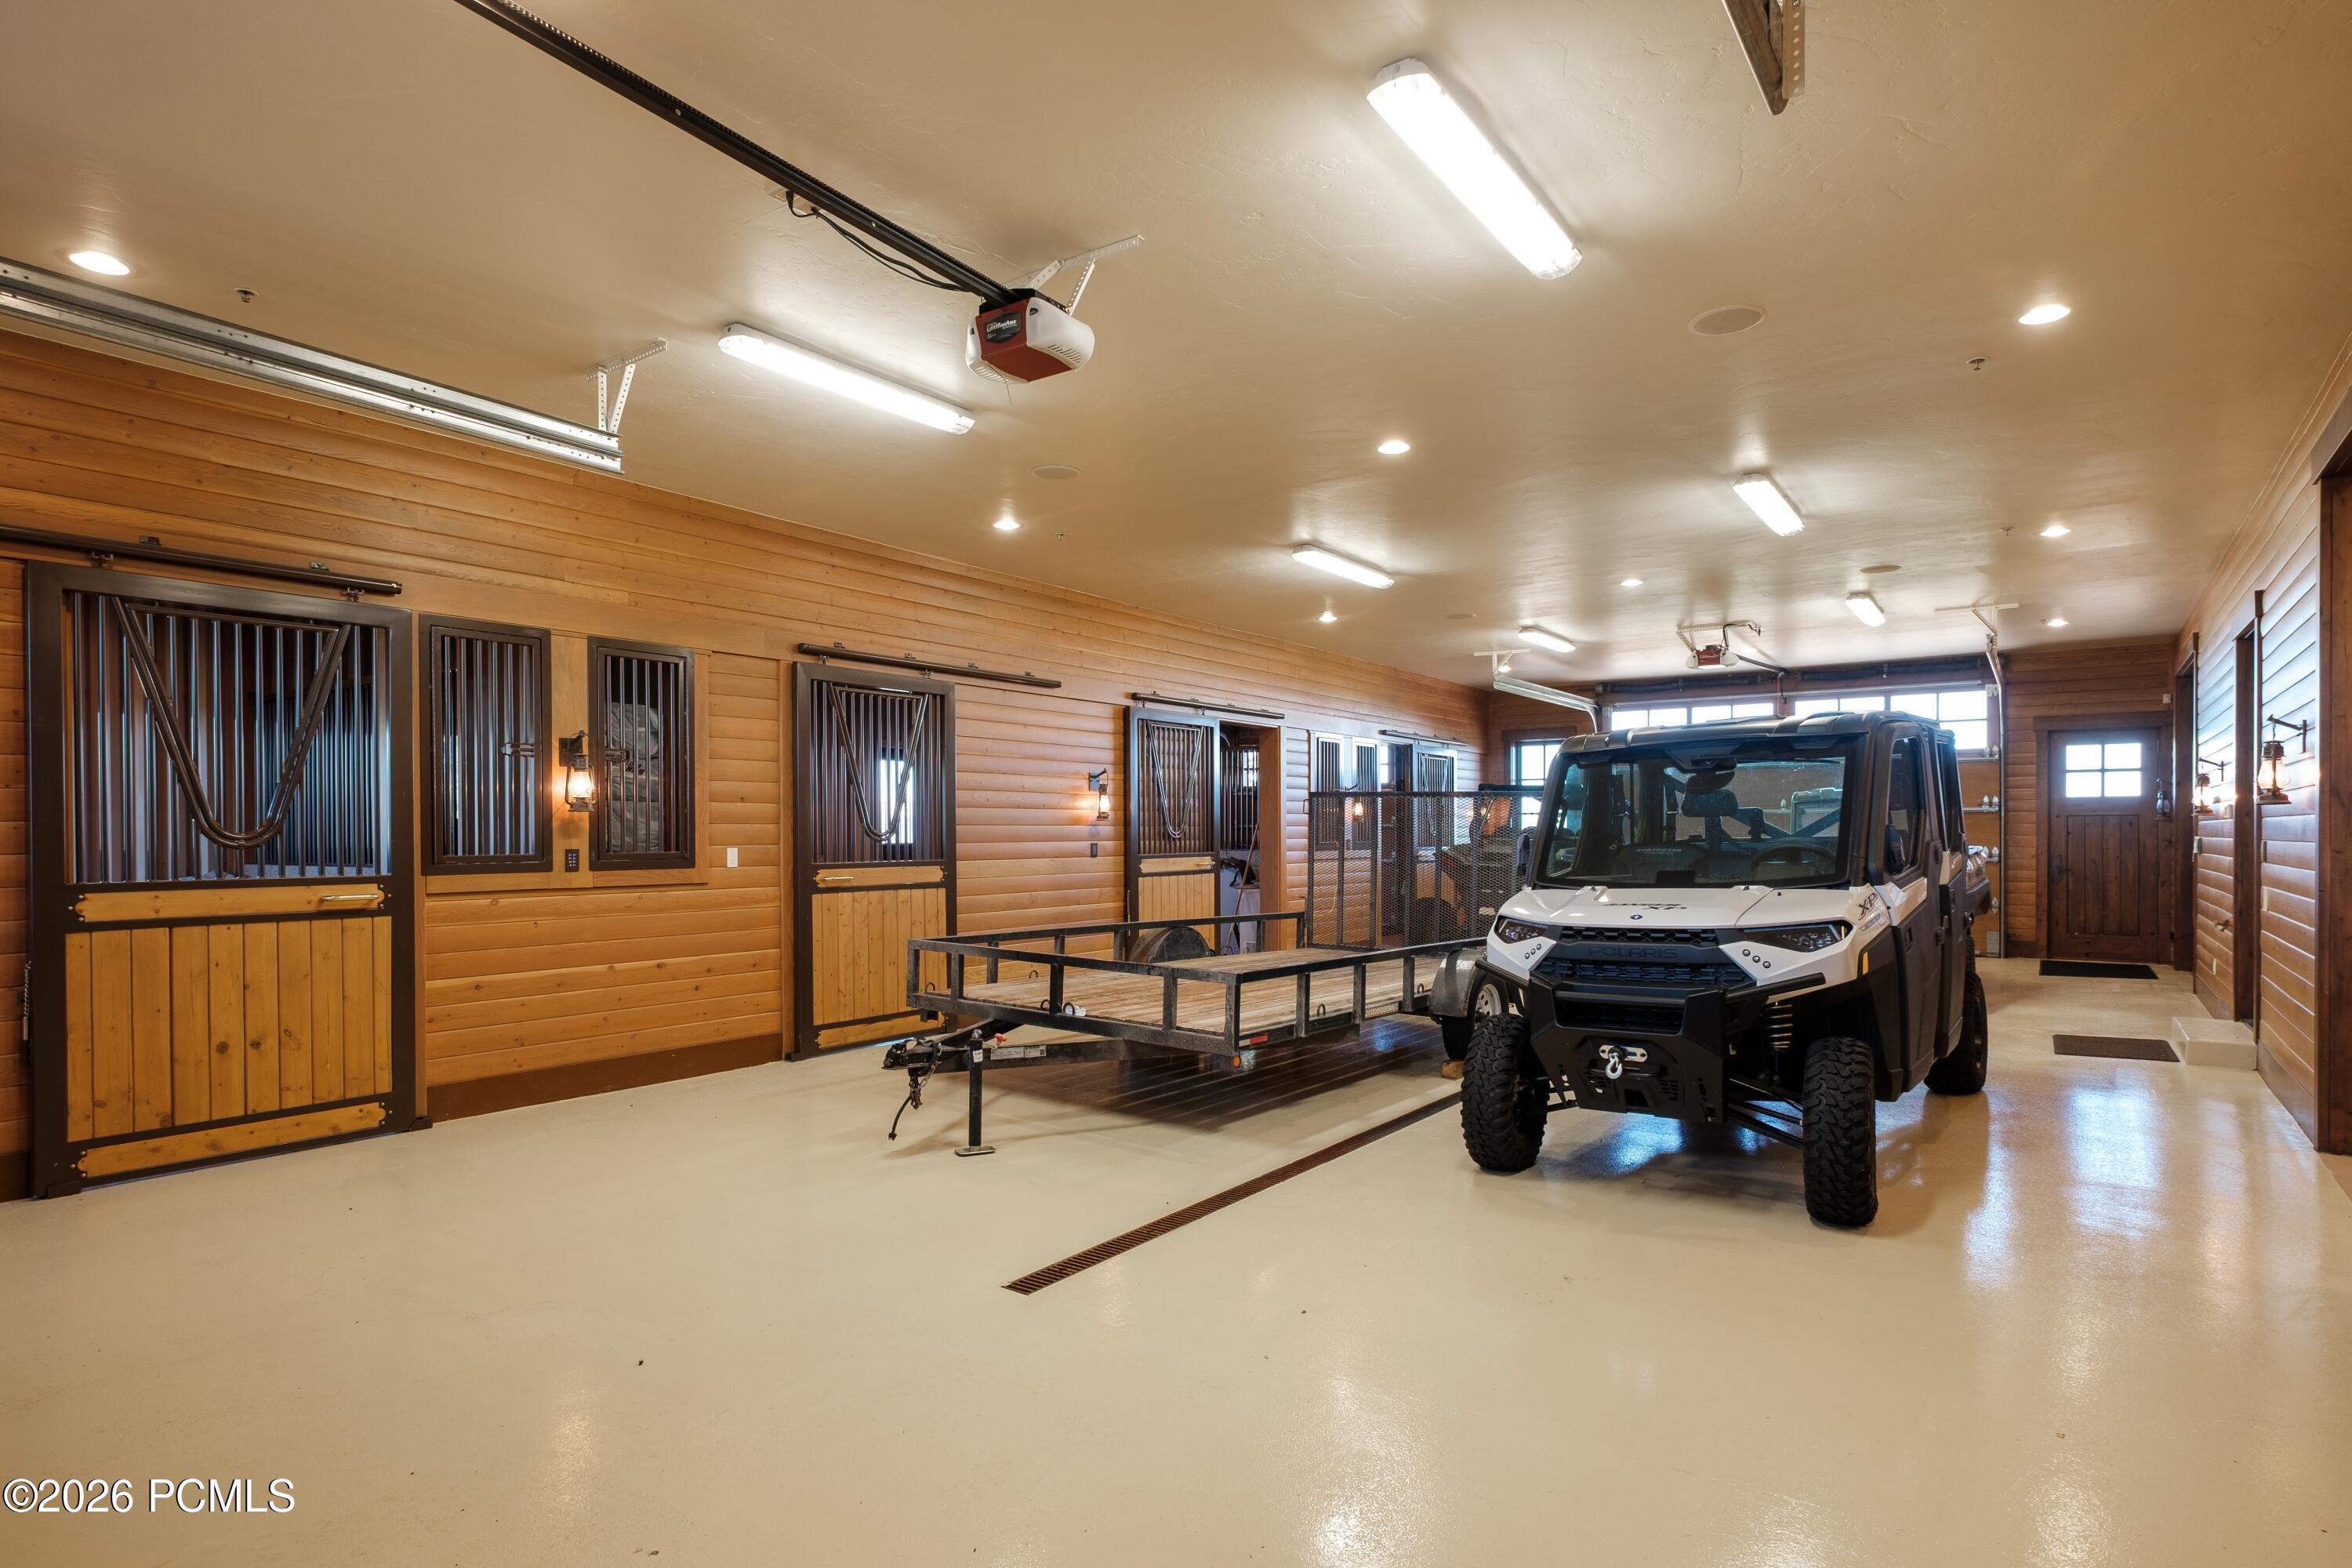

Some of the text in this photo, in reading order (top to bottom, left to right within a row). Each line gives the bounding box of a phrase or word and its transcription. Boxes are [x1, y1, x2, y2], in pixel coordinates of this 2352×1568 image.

[986, 319, 1017, 332] LiftMaster
[1857, 892, 1878, 920] XP
[1588, 946, 1678, 959] POLARIS
